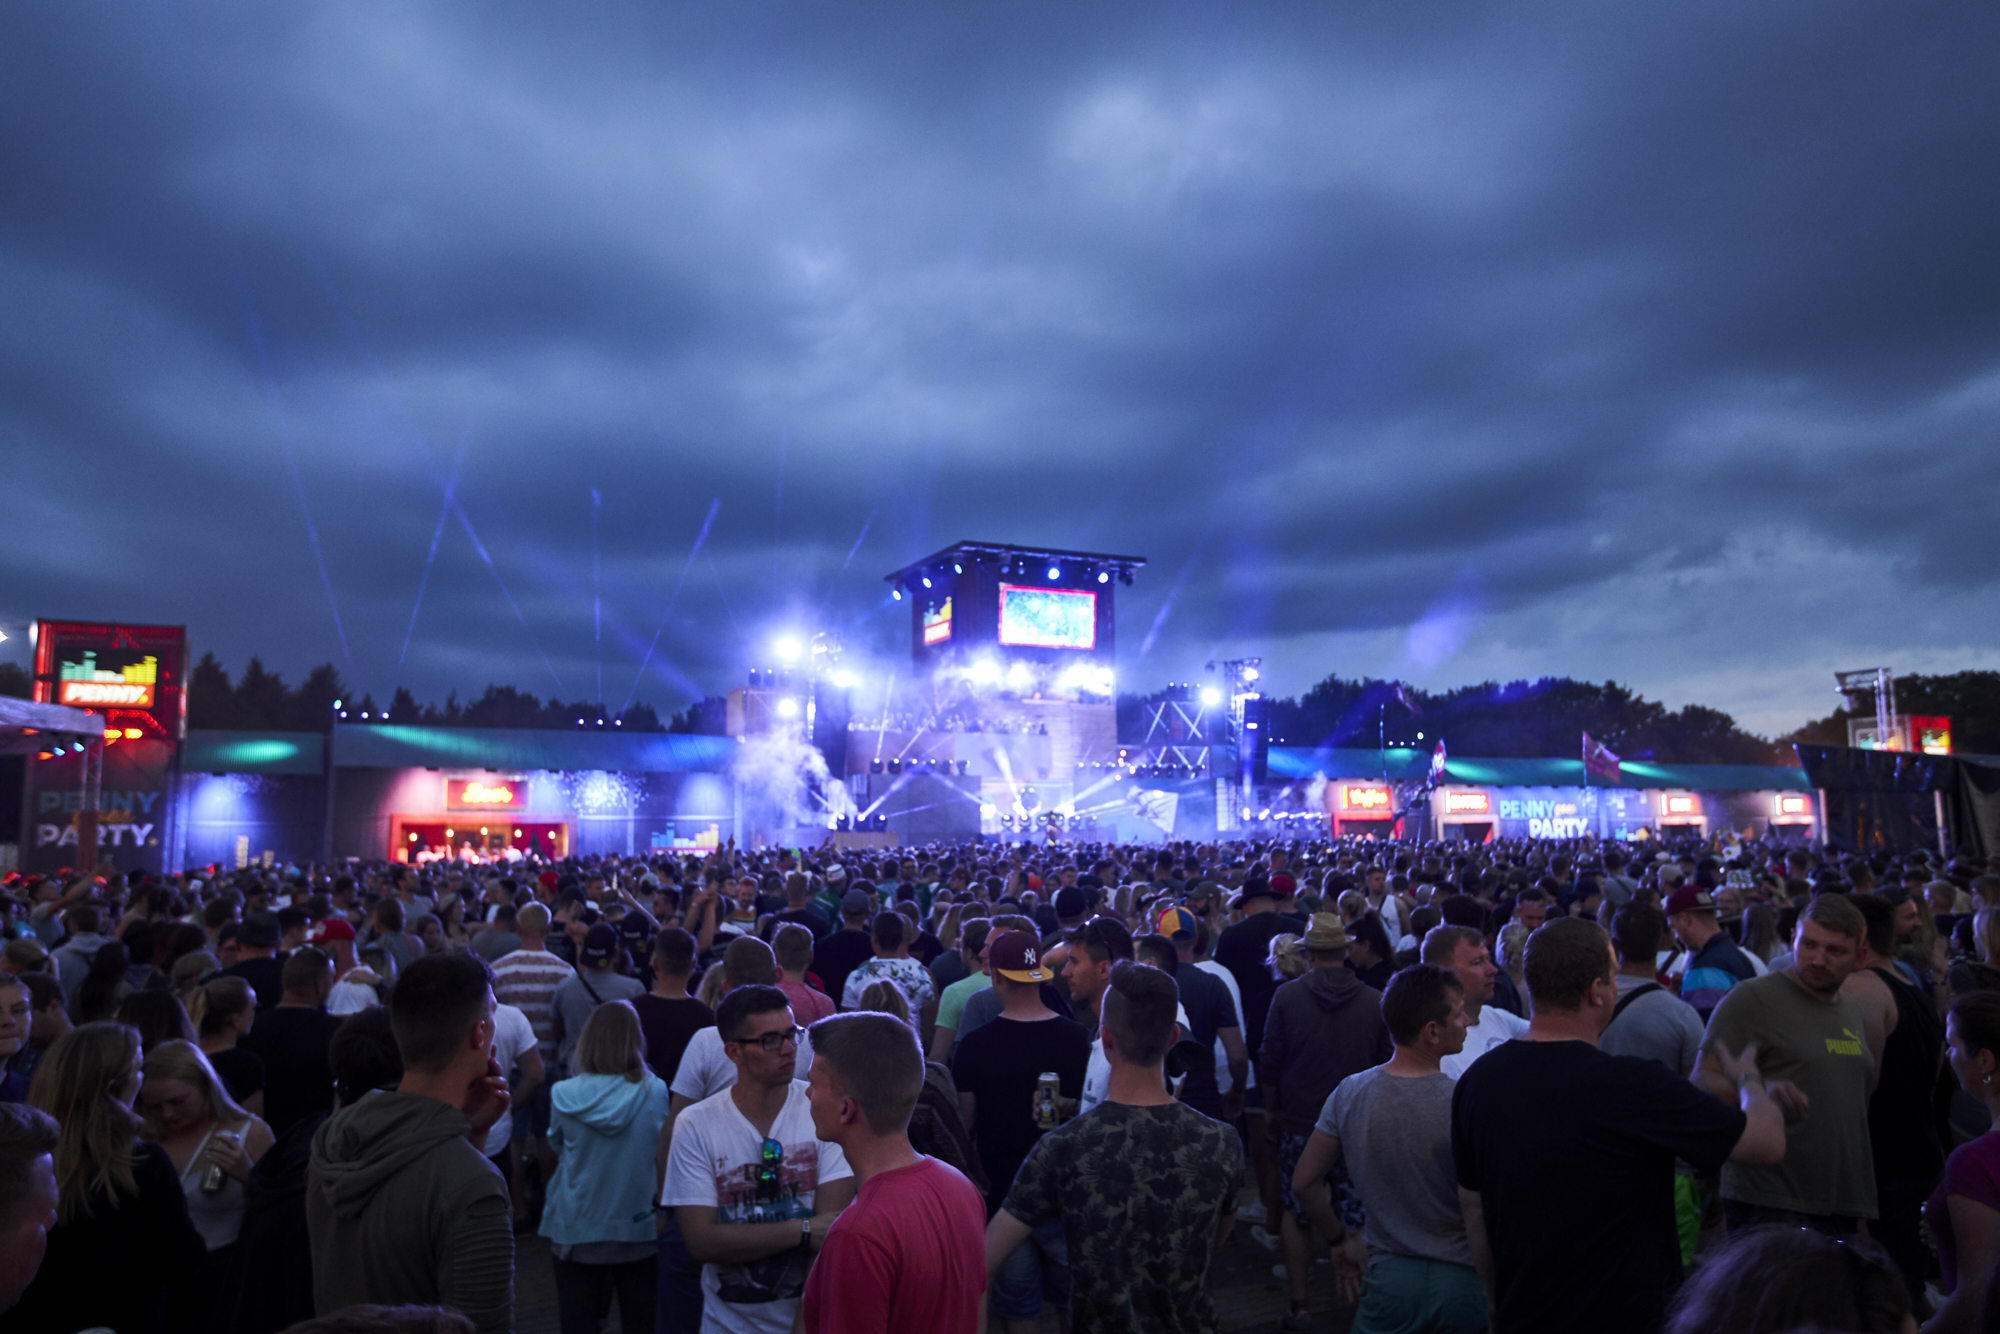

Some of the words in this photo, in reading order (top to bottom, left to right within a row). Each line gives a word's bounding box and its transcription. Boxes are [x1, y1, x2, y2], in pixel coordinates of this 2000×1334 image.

[39, 791, 159, 813] PENNY
[1499, 800, 1555, 819] PENNY
[1825, 1038, 1862, 1056] PUMA
